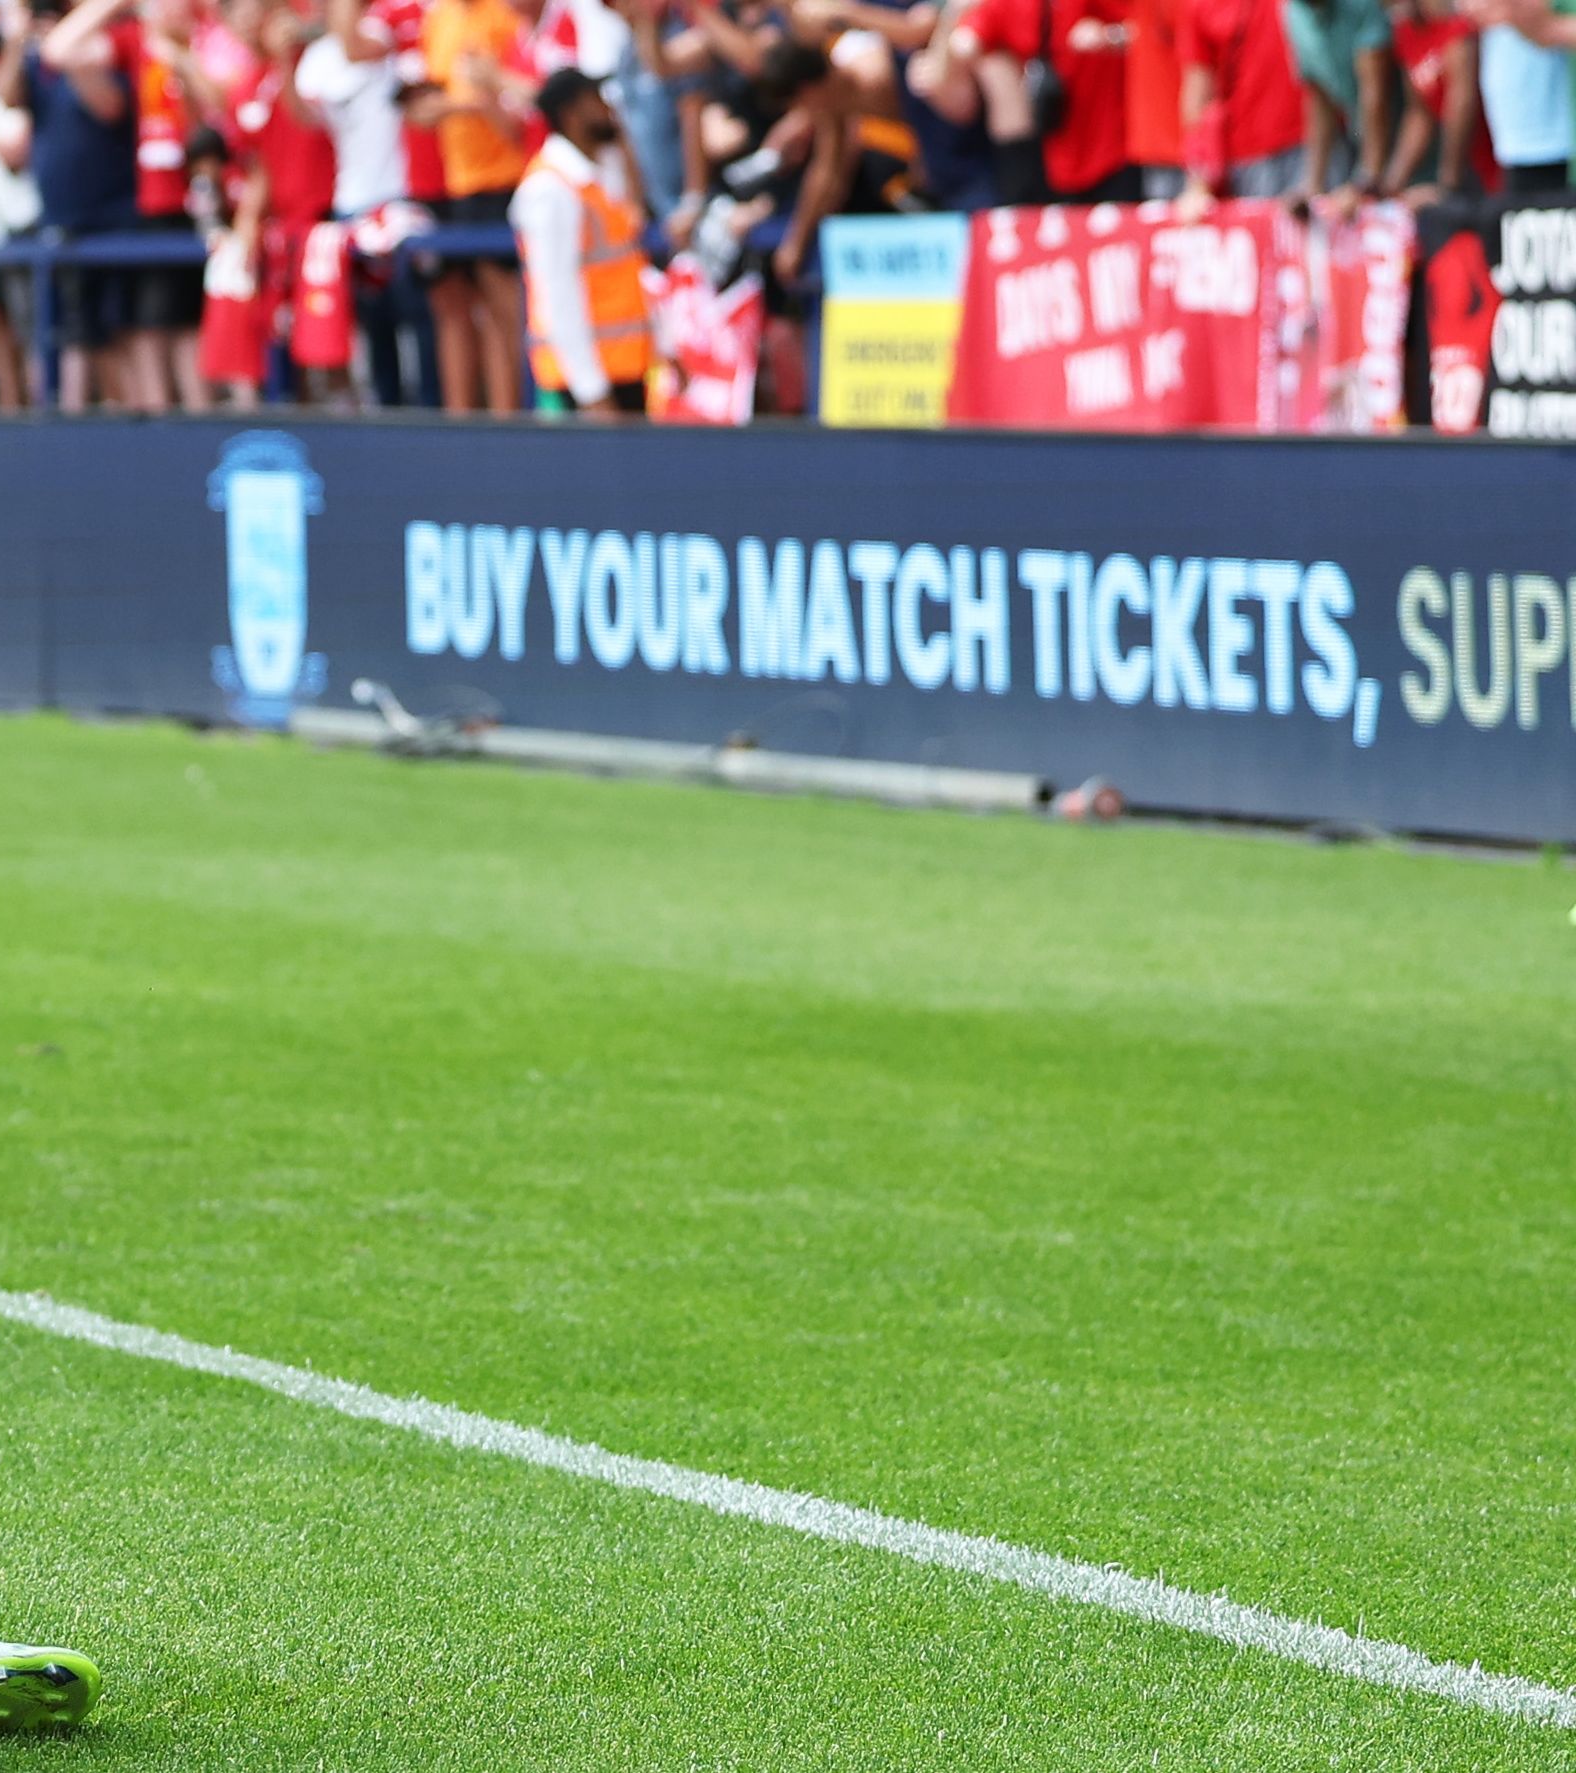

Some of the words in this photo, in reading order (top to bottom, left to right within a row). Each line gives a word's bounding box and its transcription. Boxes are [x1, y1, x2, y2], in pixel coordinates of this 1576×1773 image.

[404, 519, 537, 661] BUY
[538, 526, 730, 675] YOUR
[736, 535, 1012, 694] MATCH
[1017, 548, 1382, 749] TICKETS,
[1397, 565, 1576, 733] SUP
